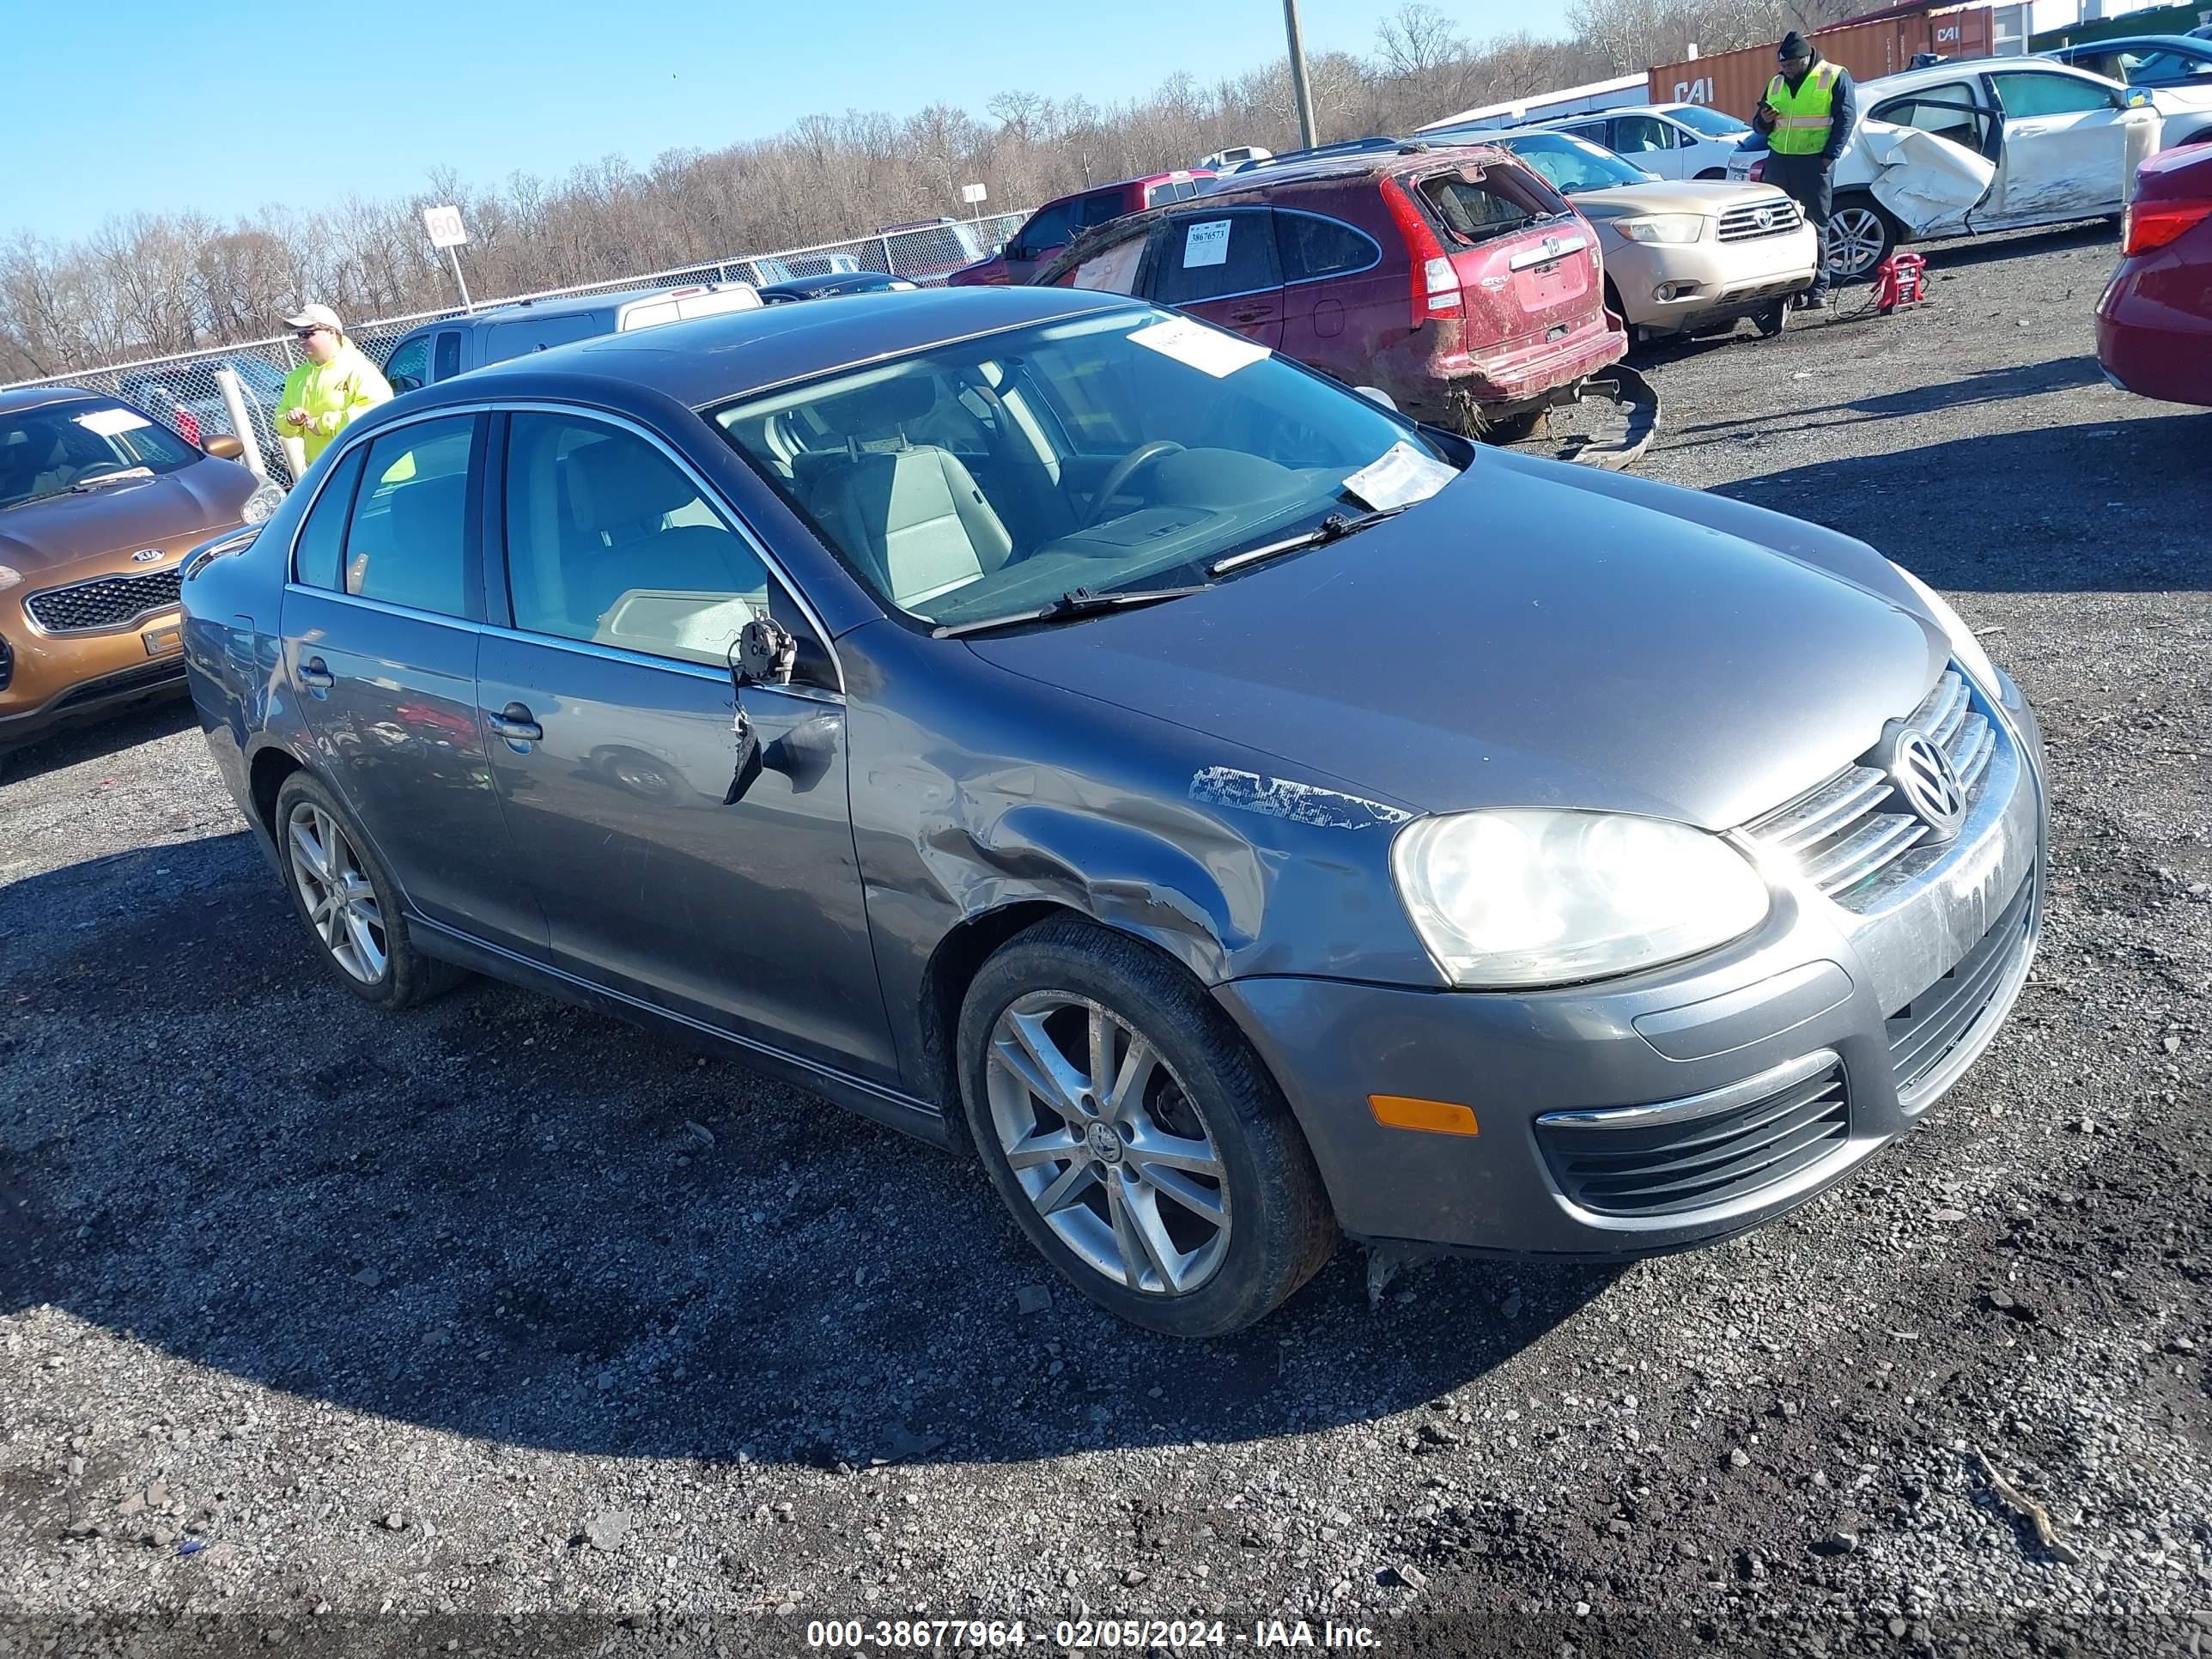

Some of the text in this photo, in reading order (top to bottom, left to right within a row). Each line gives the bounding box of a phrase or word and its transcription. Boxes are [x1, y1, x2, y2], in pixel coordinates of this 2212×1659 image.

[1674, 76, 1713, 104] CAI
[431, 216, 459, 239] 60
[1190, 230, 1224, 243] 38676573
[134, 550, 163, 562] KIA
